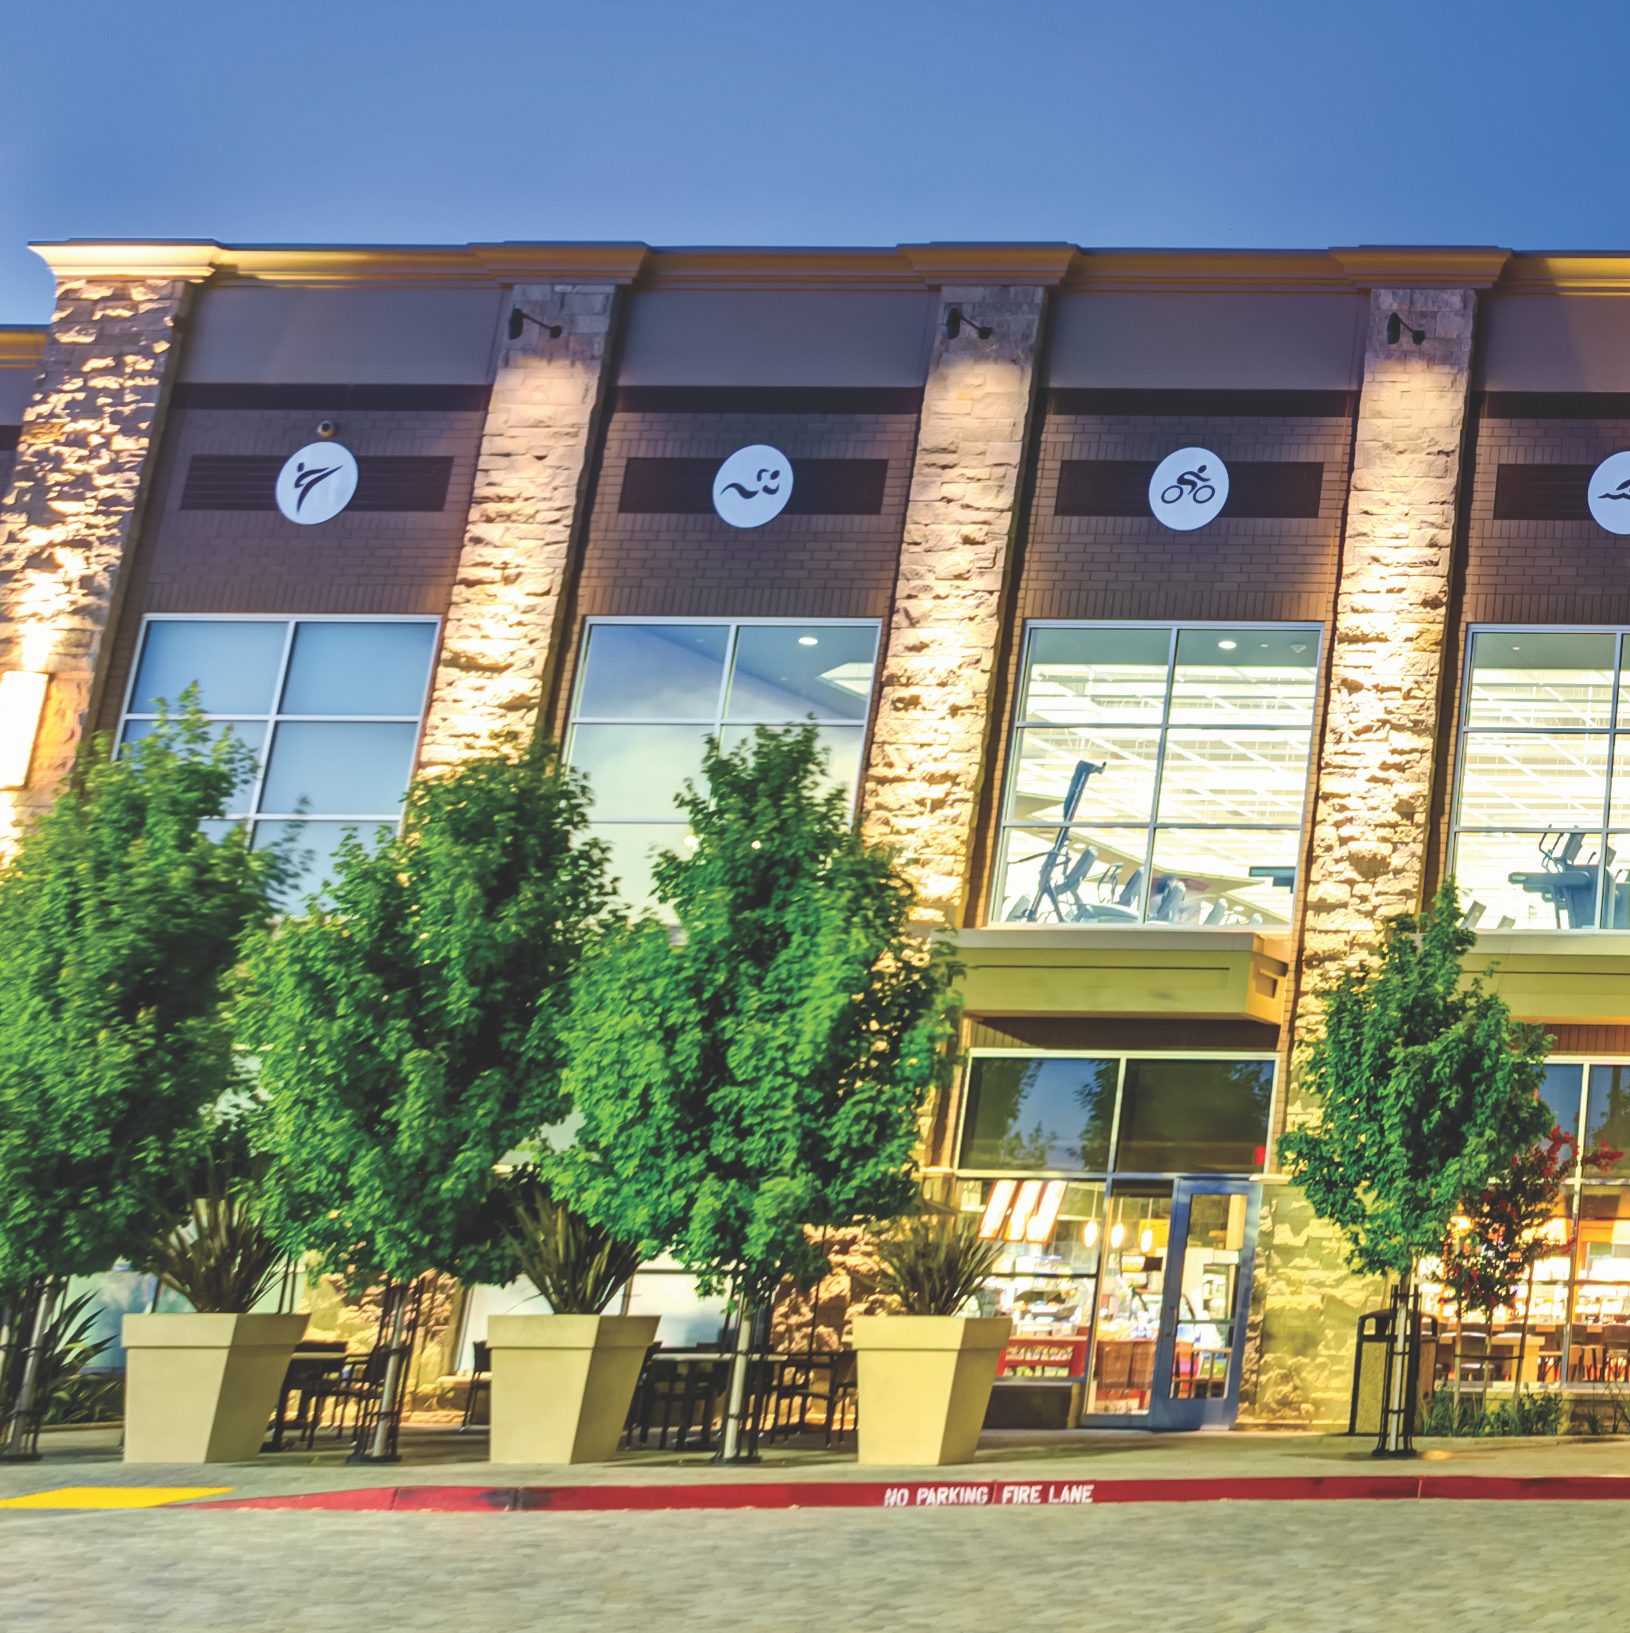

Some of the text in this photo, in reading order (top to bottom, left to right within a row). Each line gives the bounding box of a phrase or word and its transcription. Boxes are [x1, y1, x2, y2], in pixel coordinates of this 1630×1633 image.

[884, 1484, 1095, 1507] NO PARKING FIRE LANE
